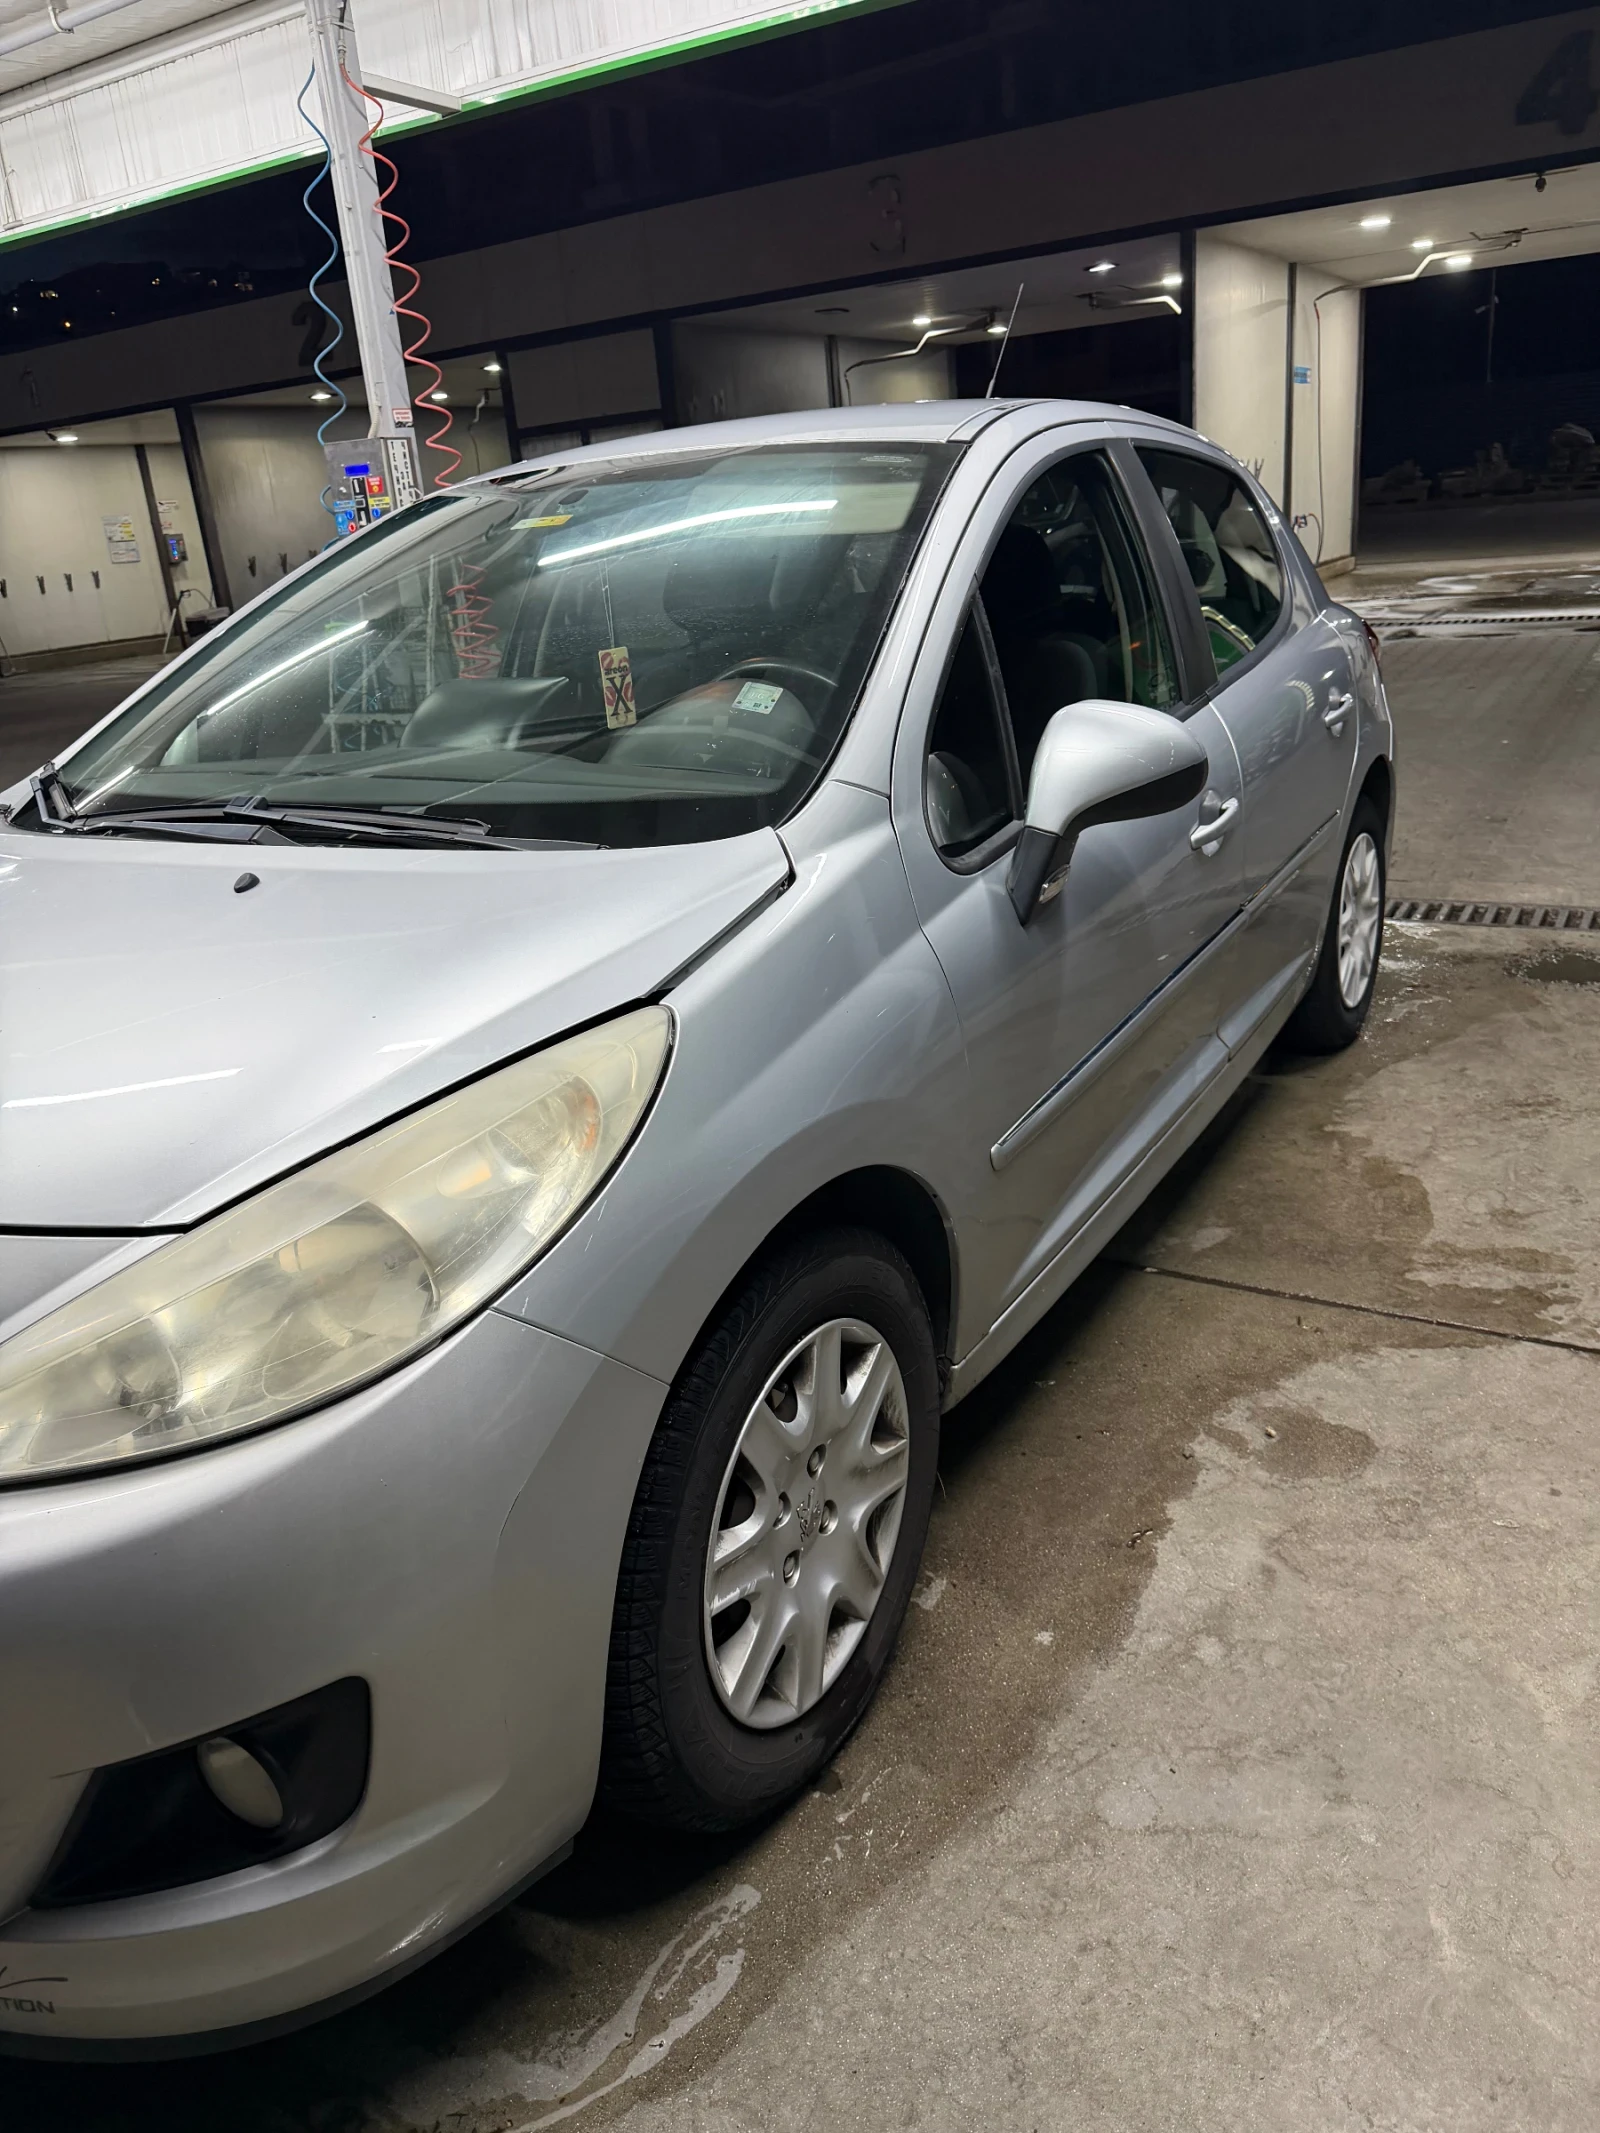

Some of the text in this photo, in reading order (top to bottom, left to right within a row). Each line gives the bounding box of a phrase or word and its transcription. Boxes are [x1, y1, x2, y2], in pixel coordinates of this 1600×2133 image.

[1515, 29, 1600, 135] 4
[292, 301, 334, 367] 2
[390, 441, 404, 507] ТЕЧНОС
[604, 664, 629, 675] areon
[606, 674, 634, 717] X
